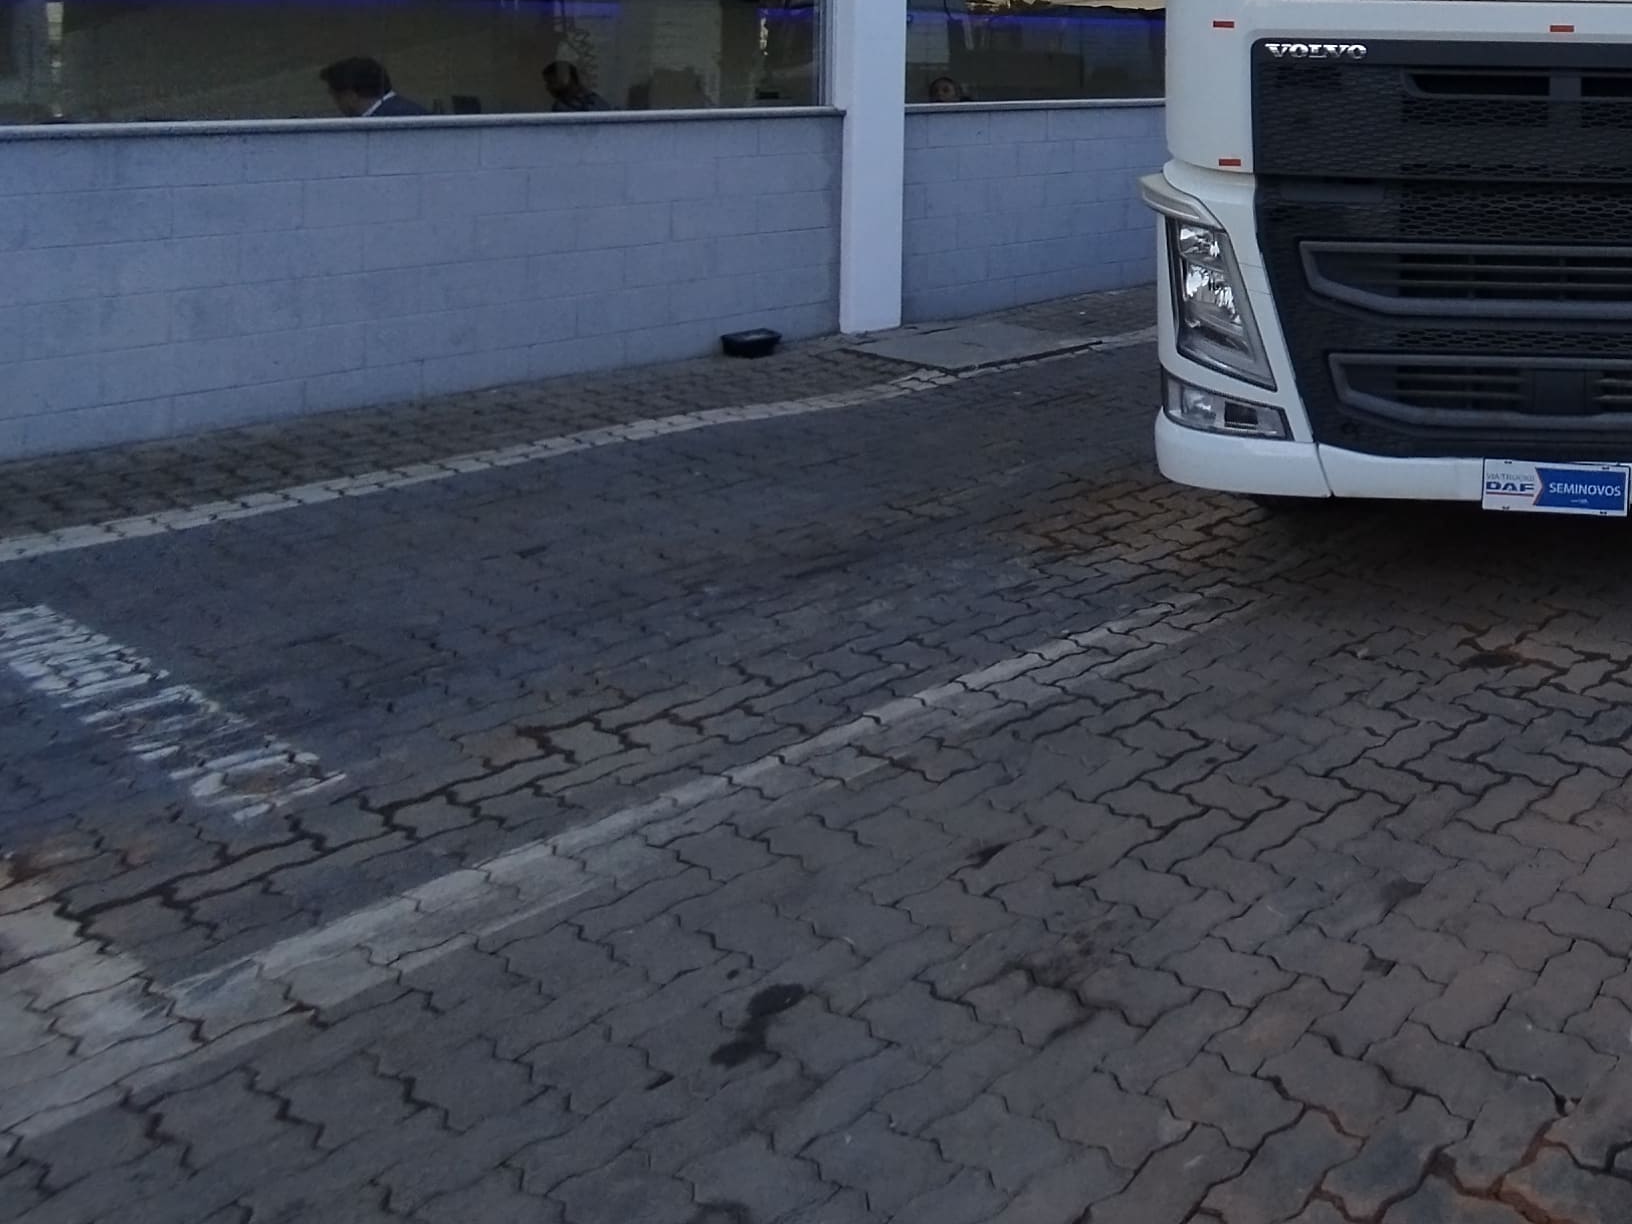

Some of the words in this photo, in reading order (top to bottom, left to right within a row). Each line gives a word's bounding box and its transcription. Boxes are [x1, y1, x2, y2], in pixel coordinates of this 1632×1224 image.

[1264, 43, 1368, 59] VOLVO
[1486, 481, 1535, 493] DAF
[1549, 482, 1621, 497] SEMINOVOS
